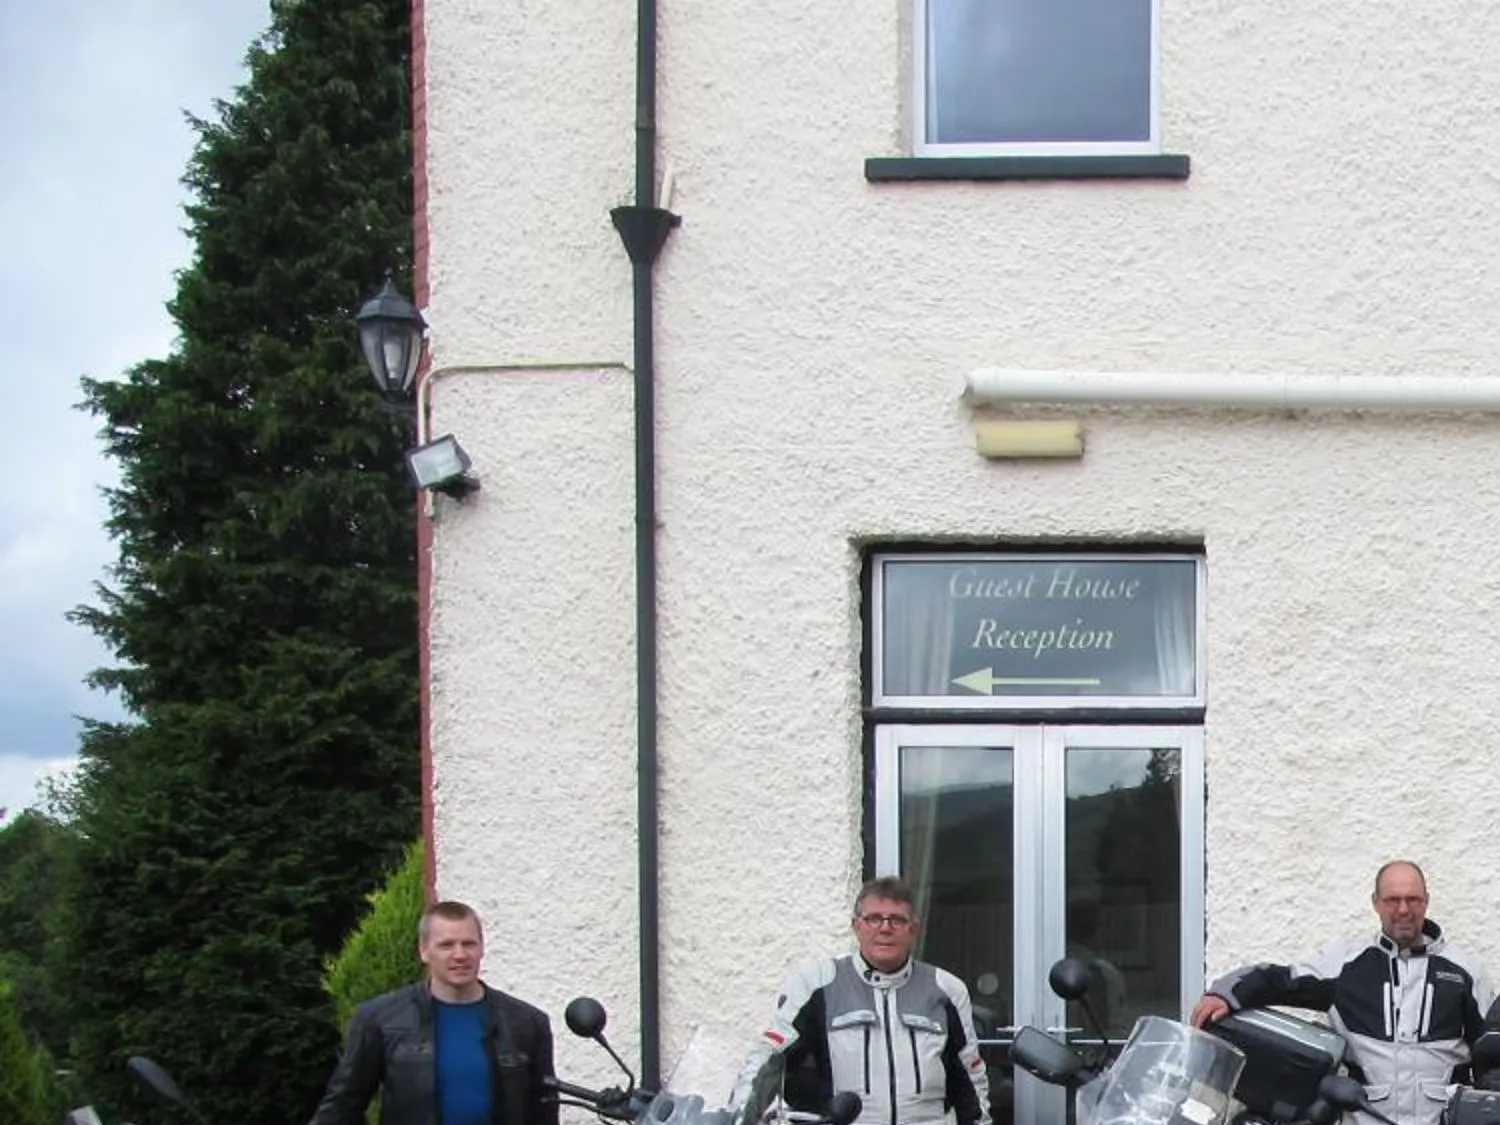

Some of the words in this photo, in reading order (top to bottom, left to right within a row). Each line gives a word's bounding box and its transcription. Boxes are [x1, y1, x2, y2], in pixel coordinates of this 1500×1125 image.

[949, 568, 1036, 599] Guest
[1046, 568, 1140, 599] House
[972, 618, 1115, 657] Reception
